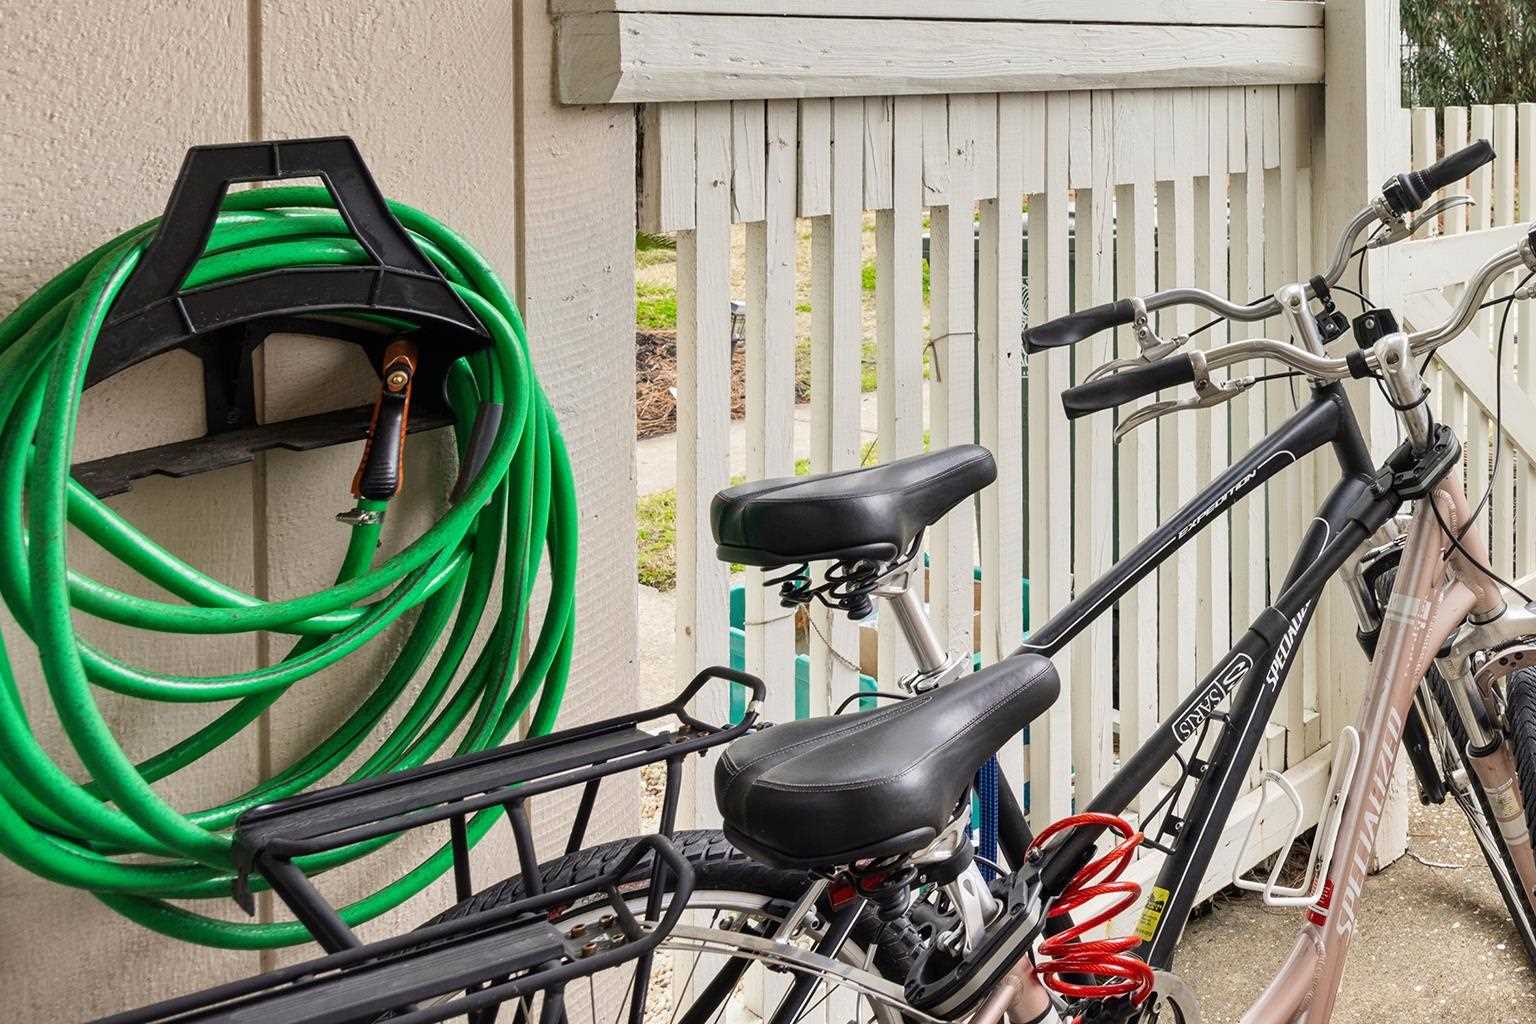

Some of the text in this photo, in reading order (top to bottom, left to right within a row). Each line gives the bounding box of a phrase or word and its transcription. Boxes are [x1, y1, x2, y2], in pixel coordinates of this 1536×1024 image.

[1178, 469, 1256, 539] EXPEDITION
[1179, 688, 1221, 739] SARIS
[1336, 706, 1402, 945] SPECIALIZED
